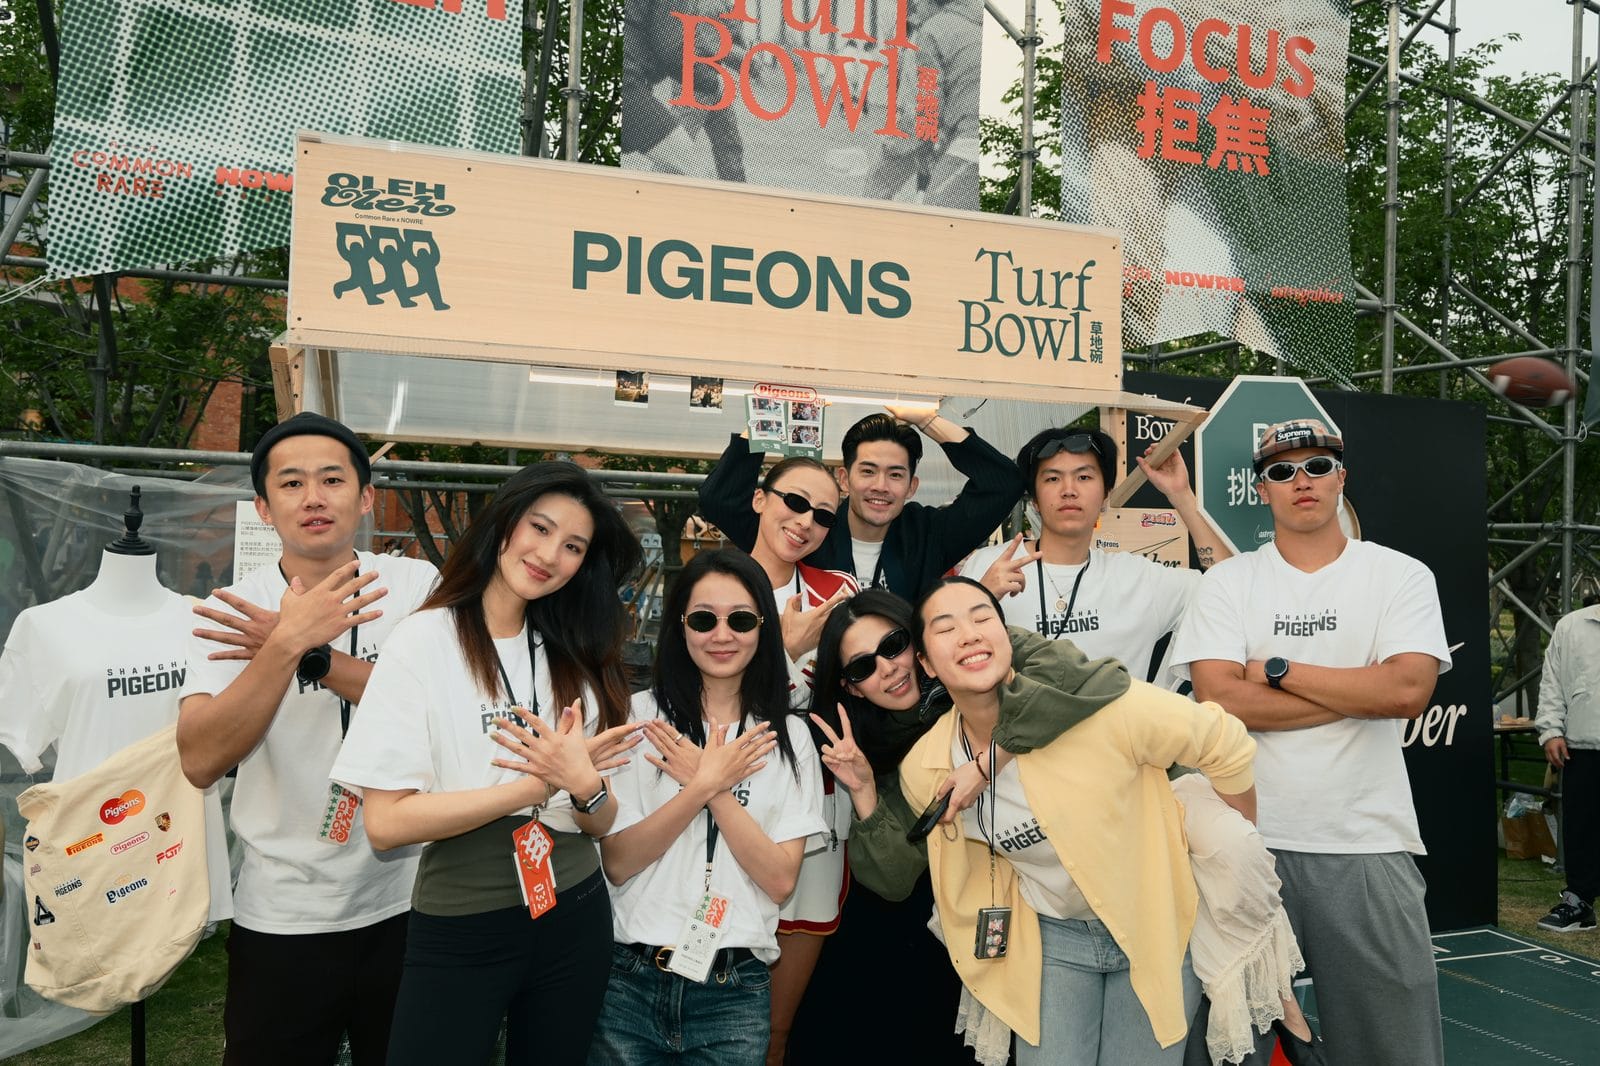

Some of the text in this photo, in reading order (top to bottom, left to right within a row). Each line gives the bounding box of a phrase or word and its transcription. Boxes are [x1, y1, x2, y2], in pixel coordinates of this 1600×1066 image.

[1096, 0, 1317, 98] FOCUS
[668, 12, 910, 139] Bowl
[1135, 80, 1273, 176] 拒焦
[72, 150, 192, 178] COMMON
[97, 173, 165, 198] RARE
[328, 172, 445, 200] OLEH
[354, 212, 381, 221] Common
[382, 215, 396, 223] Rare
[400, 217, 424, 225] NOWRE
[572, 230, 912, 318] PIGEONS
[975, 247, 1096, 312] Turf
[1165, 270, 1245, 292] NOWRE
[957, 299, 1087, 362] Bowl
[1089, 321, 1104, 364] 草地碗
[759, 385, 810, 398] Pigeons
[1135, 415, 1188, 443] Bow
[1277, 430, 1311, 440] Supreme
[107, 668, 186, 698] PIGEON
[104, 797, 140, 818] Pigeons
[113, 834, 146, 852] Pigeons
[54, 879, 83, 897] PIGEONS
[106, 878, 148, 903] Pigeons
